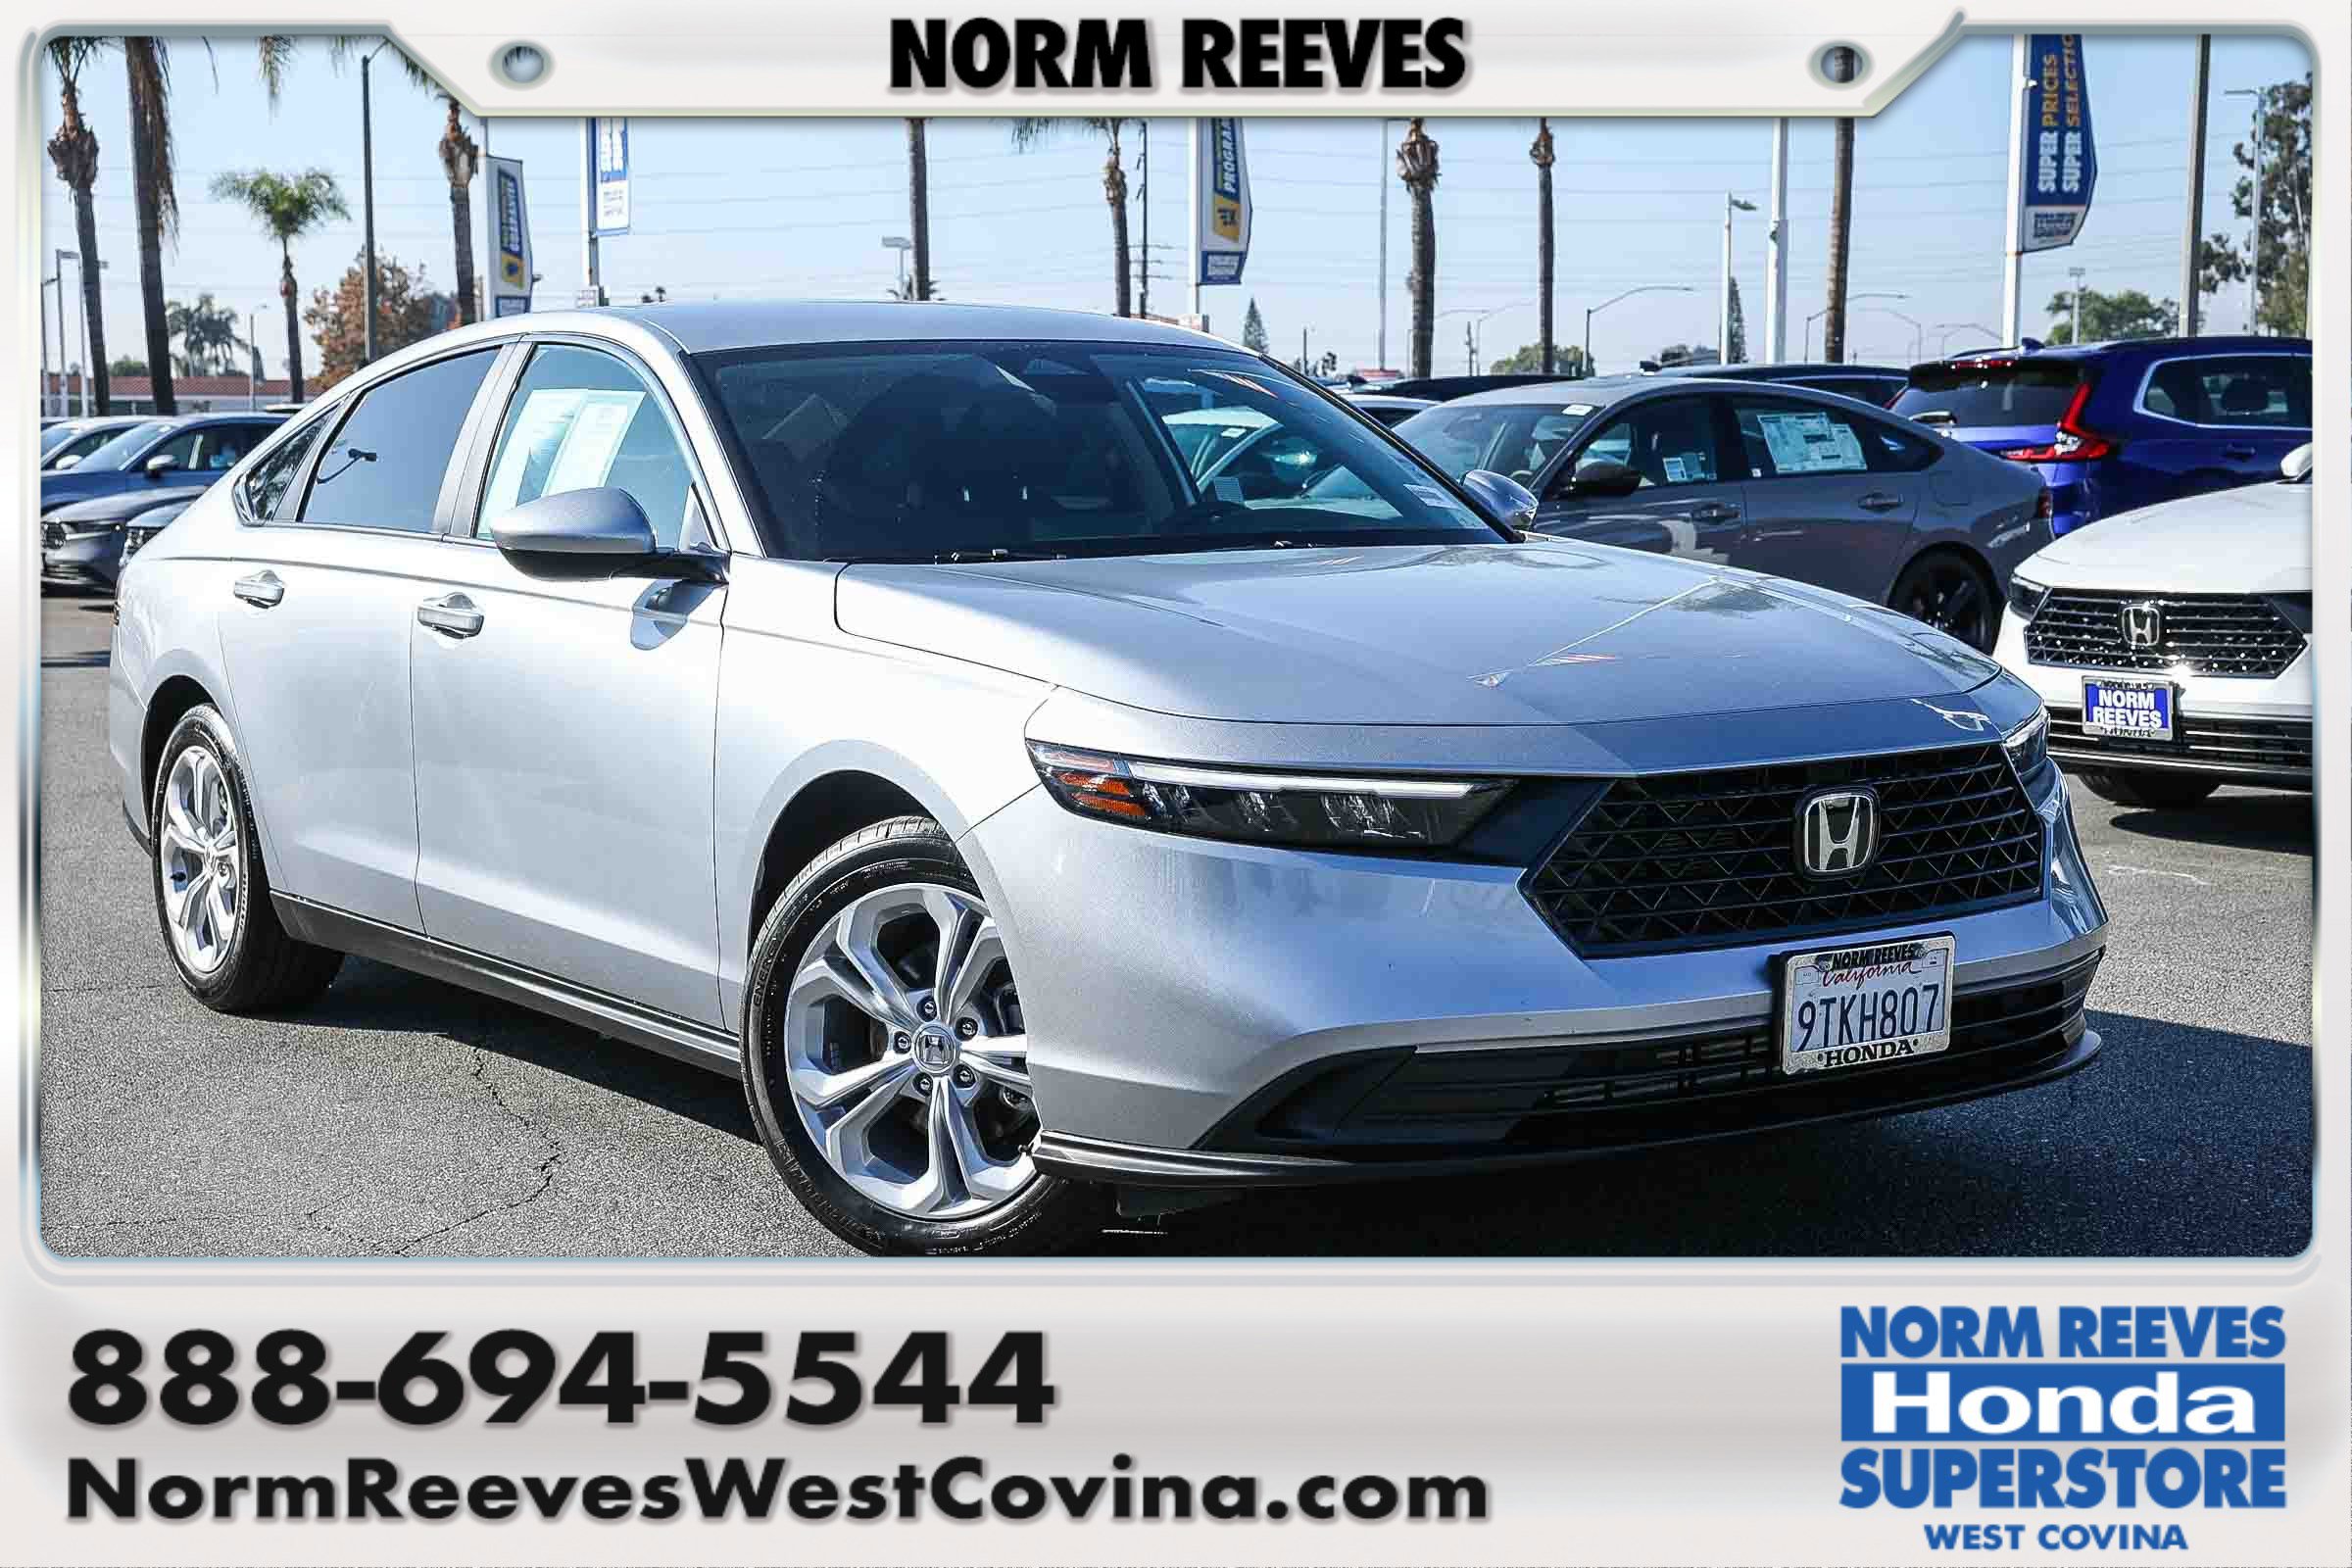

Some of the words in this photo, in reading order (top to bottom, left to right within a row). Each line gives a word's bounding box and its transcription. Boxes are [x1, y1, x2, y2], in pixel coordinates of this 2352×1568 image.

[2041, 54, 2059, 127] PRICES
[2037, 131, 2059, 194] SUPER
[2062, 131, 2082, 194] SUPER
[2098, 689, 2155, 710] NORM
[2092, 706, 2163, 730] REEVES
[1832, 949, 1870, 970] NORM
[1874, 943, 1914, 964] REEVES
[1823, 961, 1922, 990] California
[1796, 984, 1939, 1053] 9TKH807
[1824, 1039, 1914, 1067] HONDA
